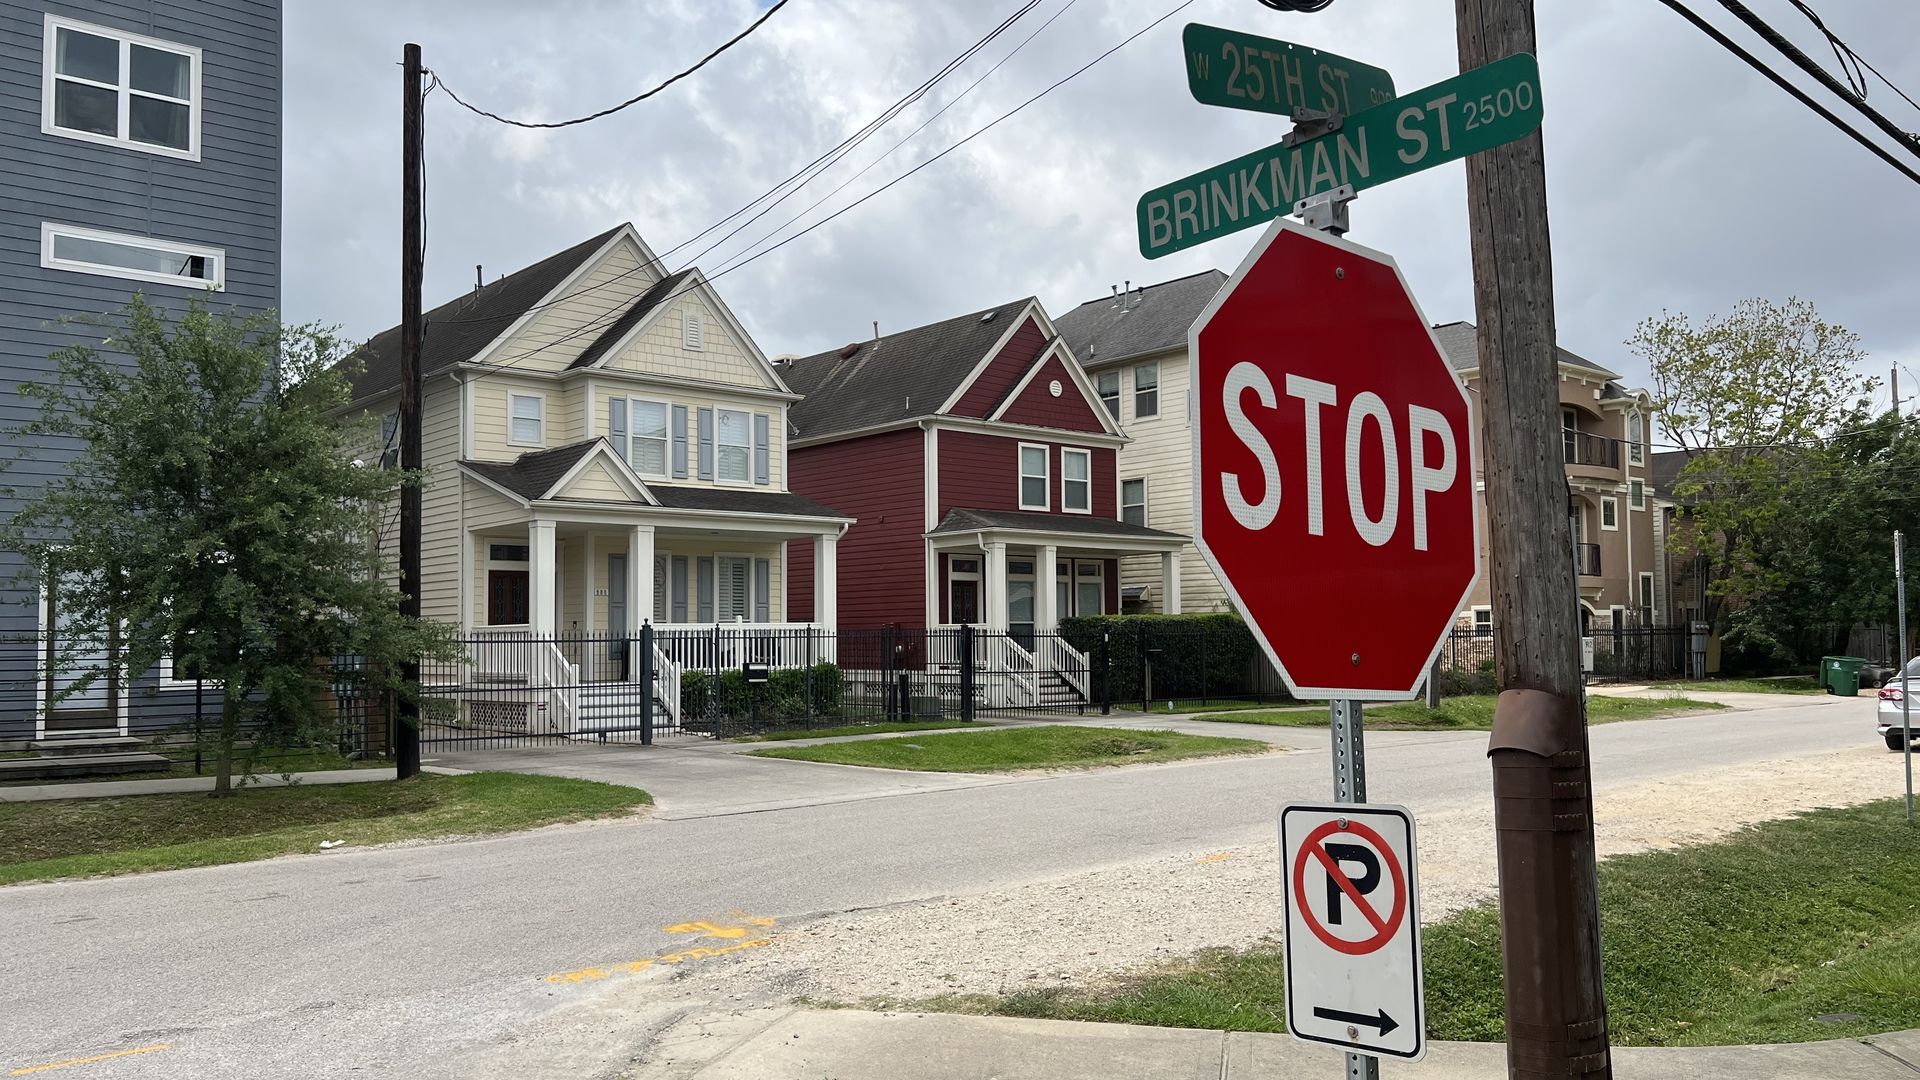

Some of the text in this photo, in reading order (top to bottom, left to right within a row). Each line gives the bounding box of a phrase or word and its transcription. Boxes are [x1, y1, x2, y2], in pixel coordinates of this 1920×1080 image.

[1193, 52, 1209, 81] W
[1222, 42, 1306, 107] 25TH
[1319, 63, 1350, 117] ST
[1147, 81, 1534, 249] BRINKMAN ST 2500
[1220, 361, 1457, 551] STOP
[1324, 842, 1381, 925] P
